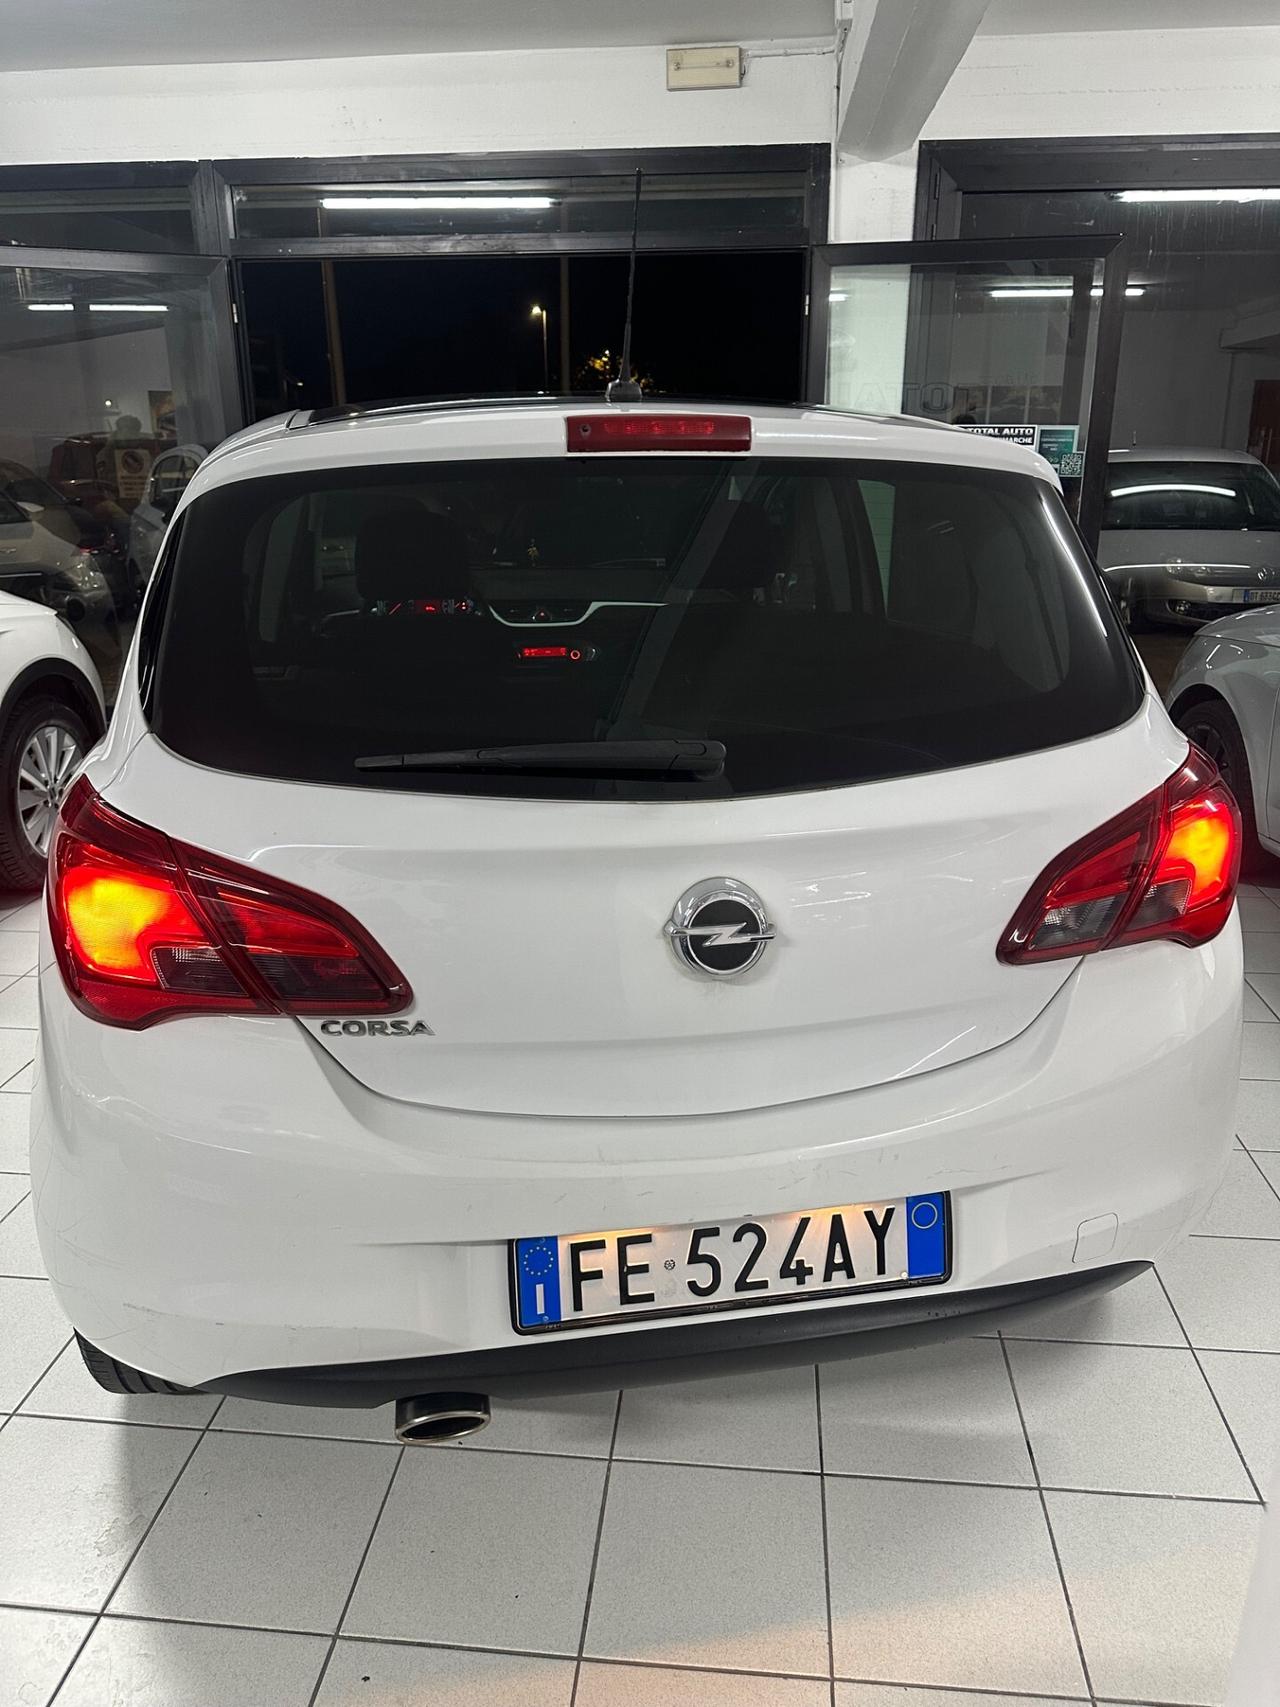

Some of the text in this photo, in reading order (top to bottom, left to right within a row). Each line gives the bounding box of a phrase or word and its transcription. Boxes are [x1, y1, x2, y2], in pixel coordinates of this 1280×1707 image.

[1002, 427, 1034, 436] AUTO
[320, 1020, 436, 1037] CORSA
[568, 1205, 896, 1312] FE 524AY
[535, 1283, 545, 1315] I
